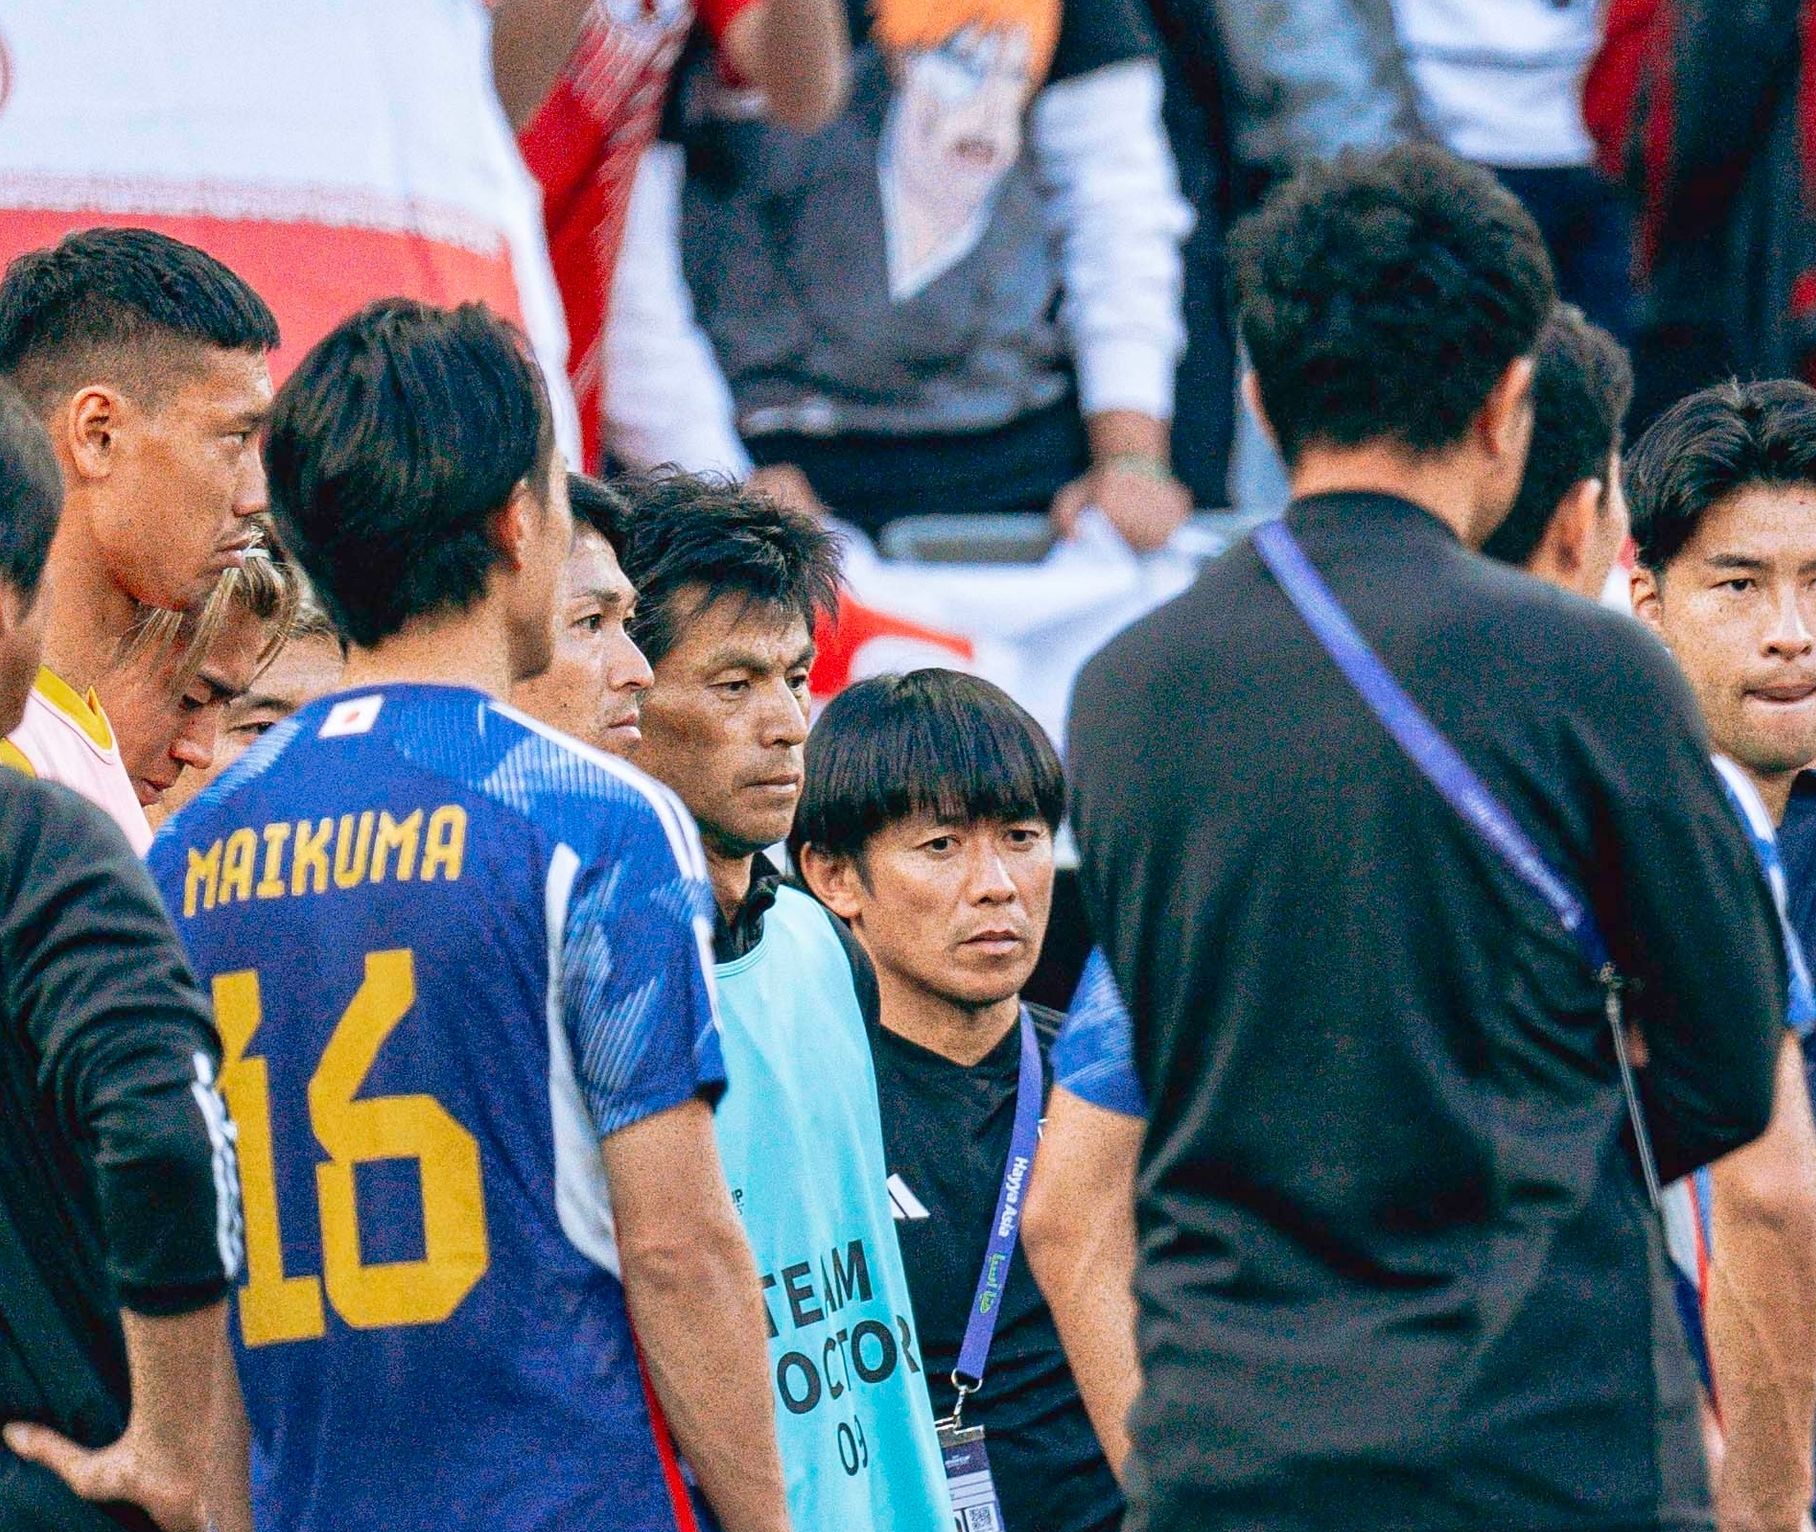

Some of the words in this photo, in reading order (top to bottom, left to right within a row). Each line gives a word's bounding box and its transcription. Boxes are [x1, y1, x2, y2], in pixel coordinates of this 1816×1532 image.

[183, 804, 467, 918] MAIKUMA
[211, 948, 490, 1349] 16
[1006, 1156, 1029, 1204] Hayya
[998, 1204, 1018, 1238] Asia
[761, 1239, 873, 1339] TEAM
[776, 1314, 921, 1415] OCTOR
